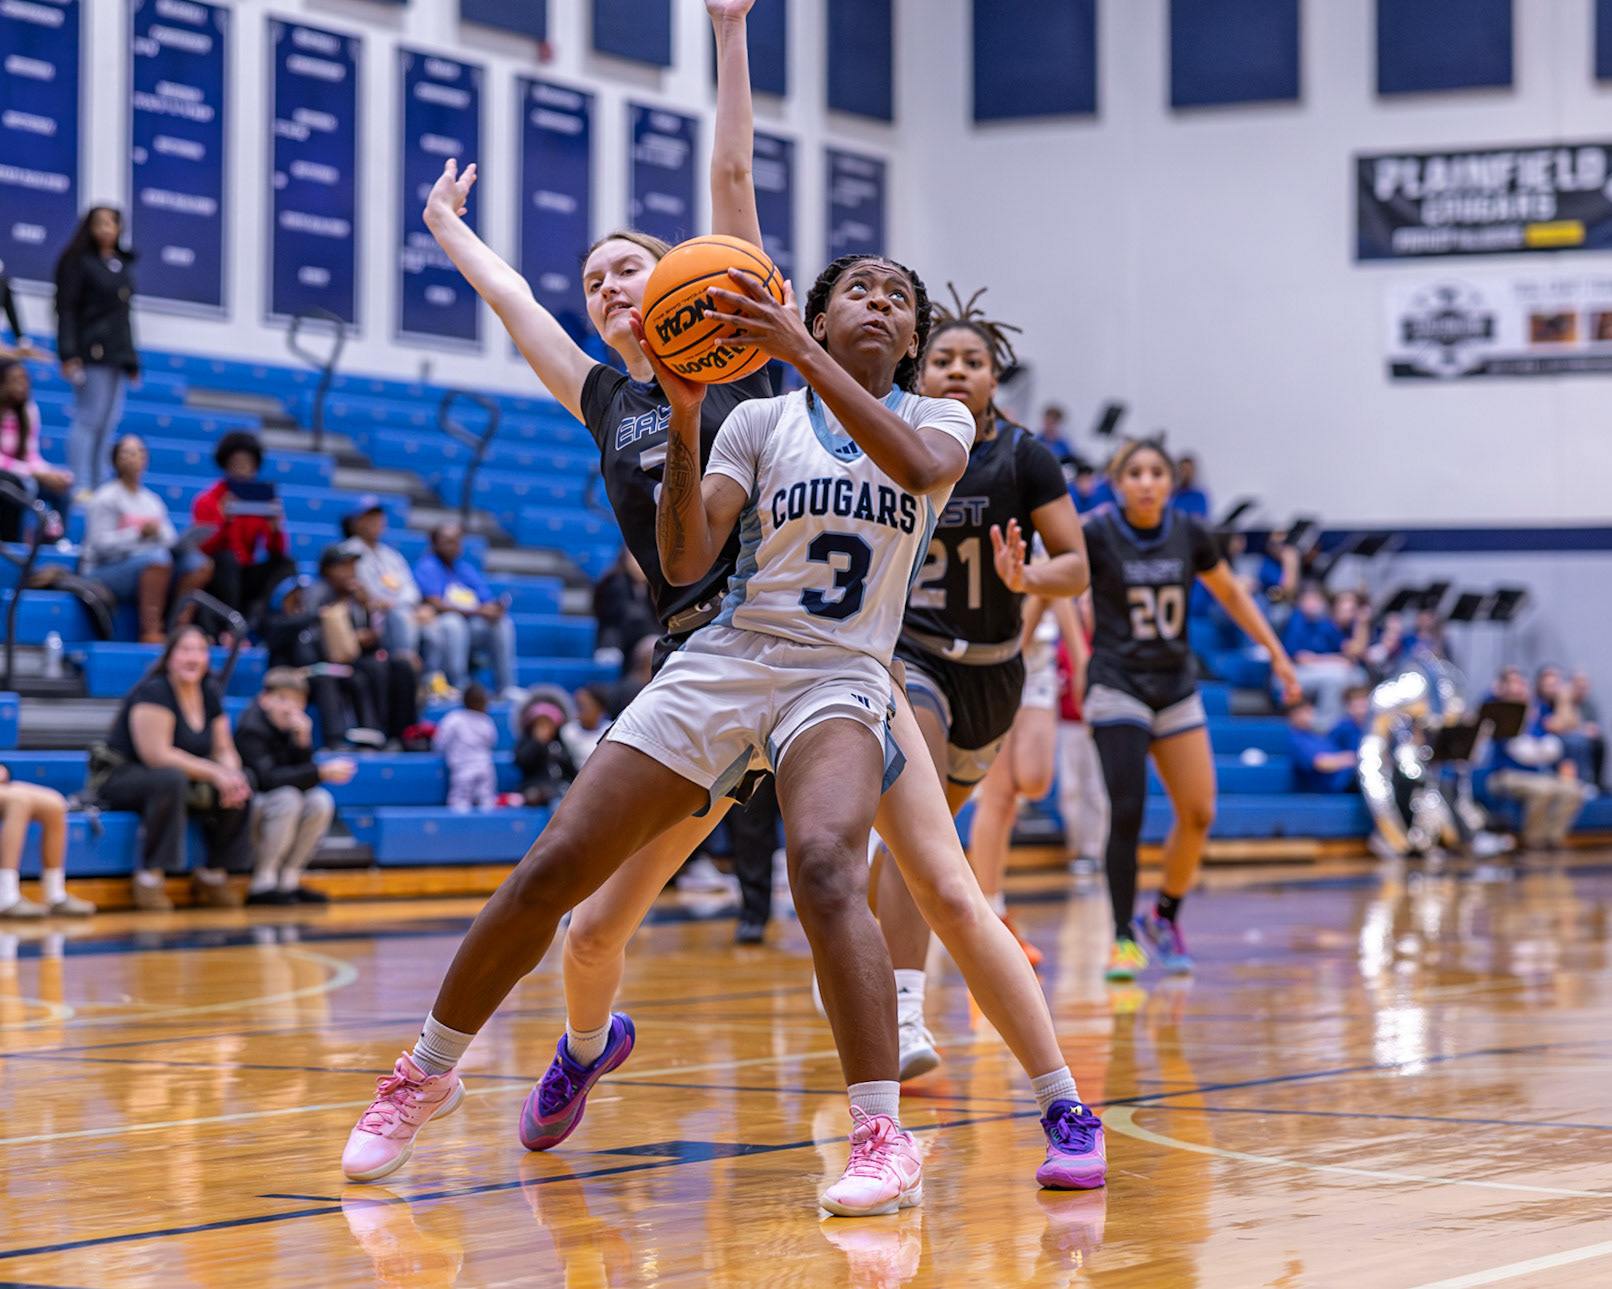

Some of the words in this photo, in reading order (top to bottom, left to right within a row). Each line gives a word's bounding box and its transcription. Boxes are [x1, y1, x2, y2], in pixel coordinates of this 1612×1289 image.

[654, 294, 718, 345] NCAA
[615, 405, 672, 451] EAS
[772, 477, 917, 535] COUGARS
[798, 530, 874, 622] 3
[909, 537, 983, 610] 21
[1127, 585, 1186, 640] 20
